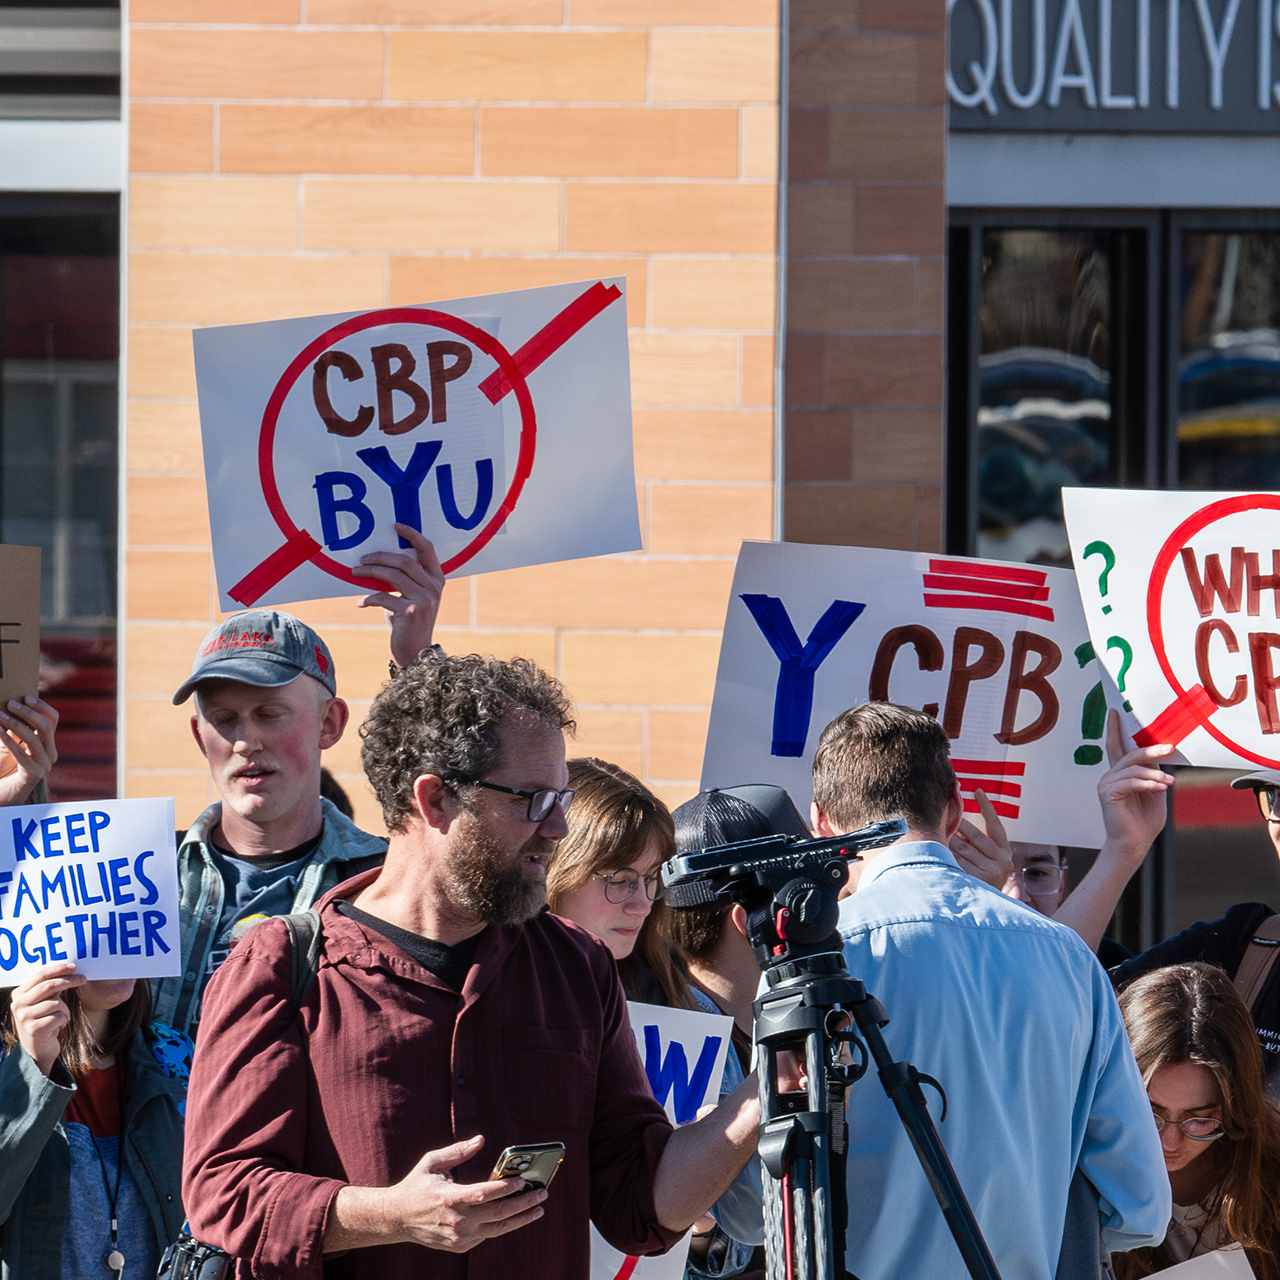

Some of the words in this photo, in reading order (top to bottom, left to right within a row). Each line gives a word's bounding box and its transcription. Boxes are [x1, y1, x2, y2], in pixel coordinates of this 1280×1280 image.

[312, 340, 473, 437] CBP
[314, 440, 494, 553] BYU
[738, 593, 867, 758] Y
[11, 809, 111, 863] KEEP
